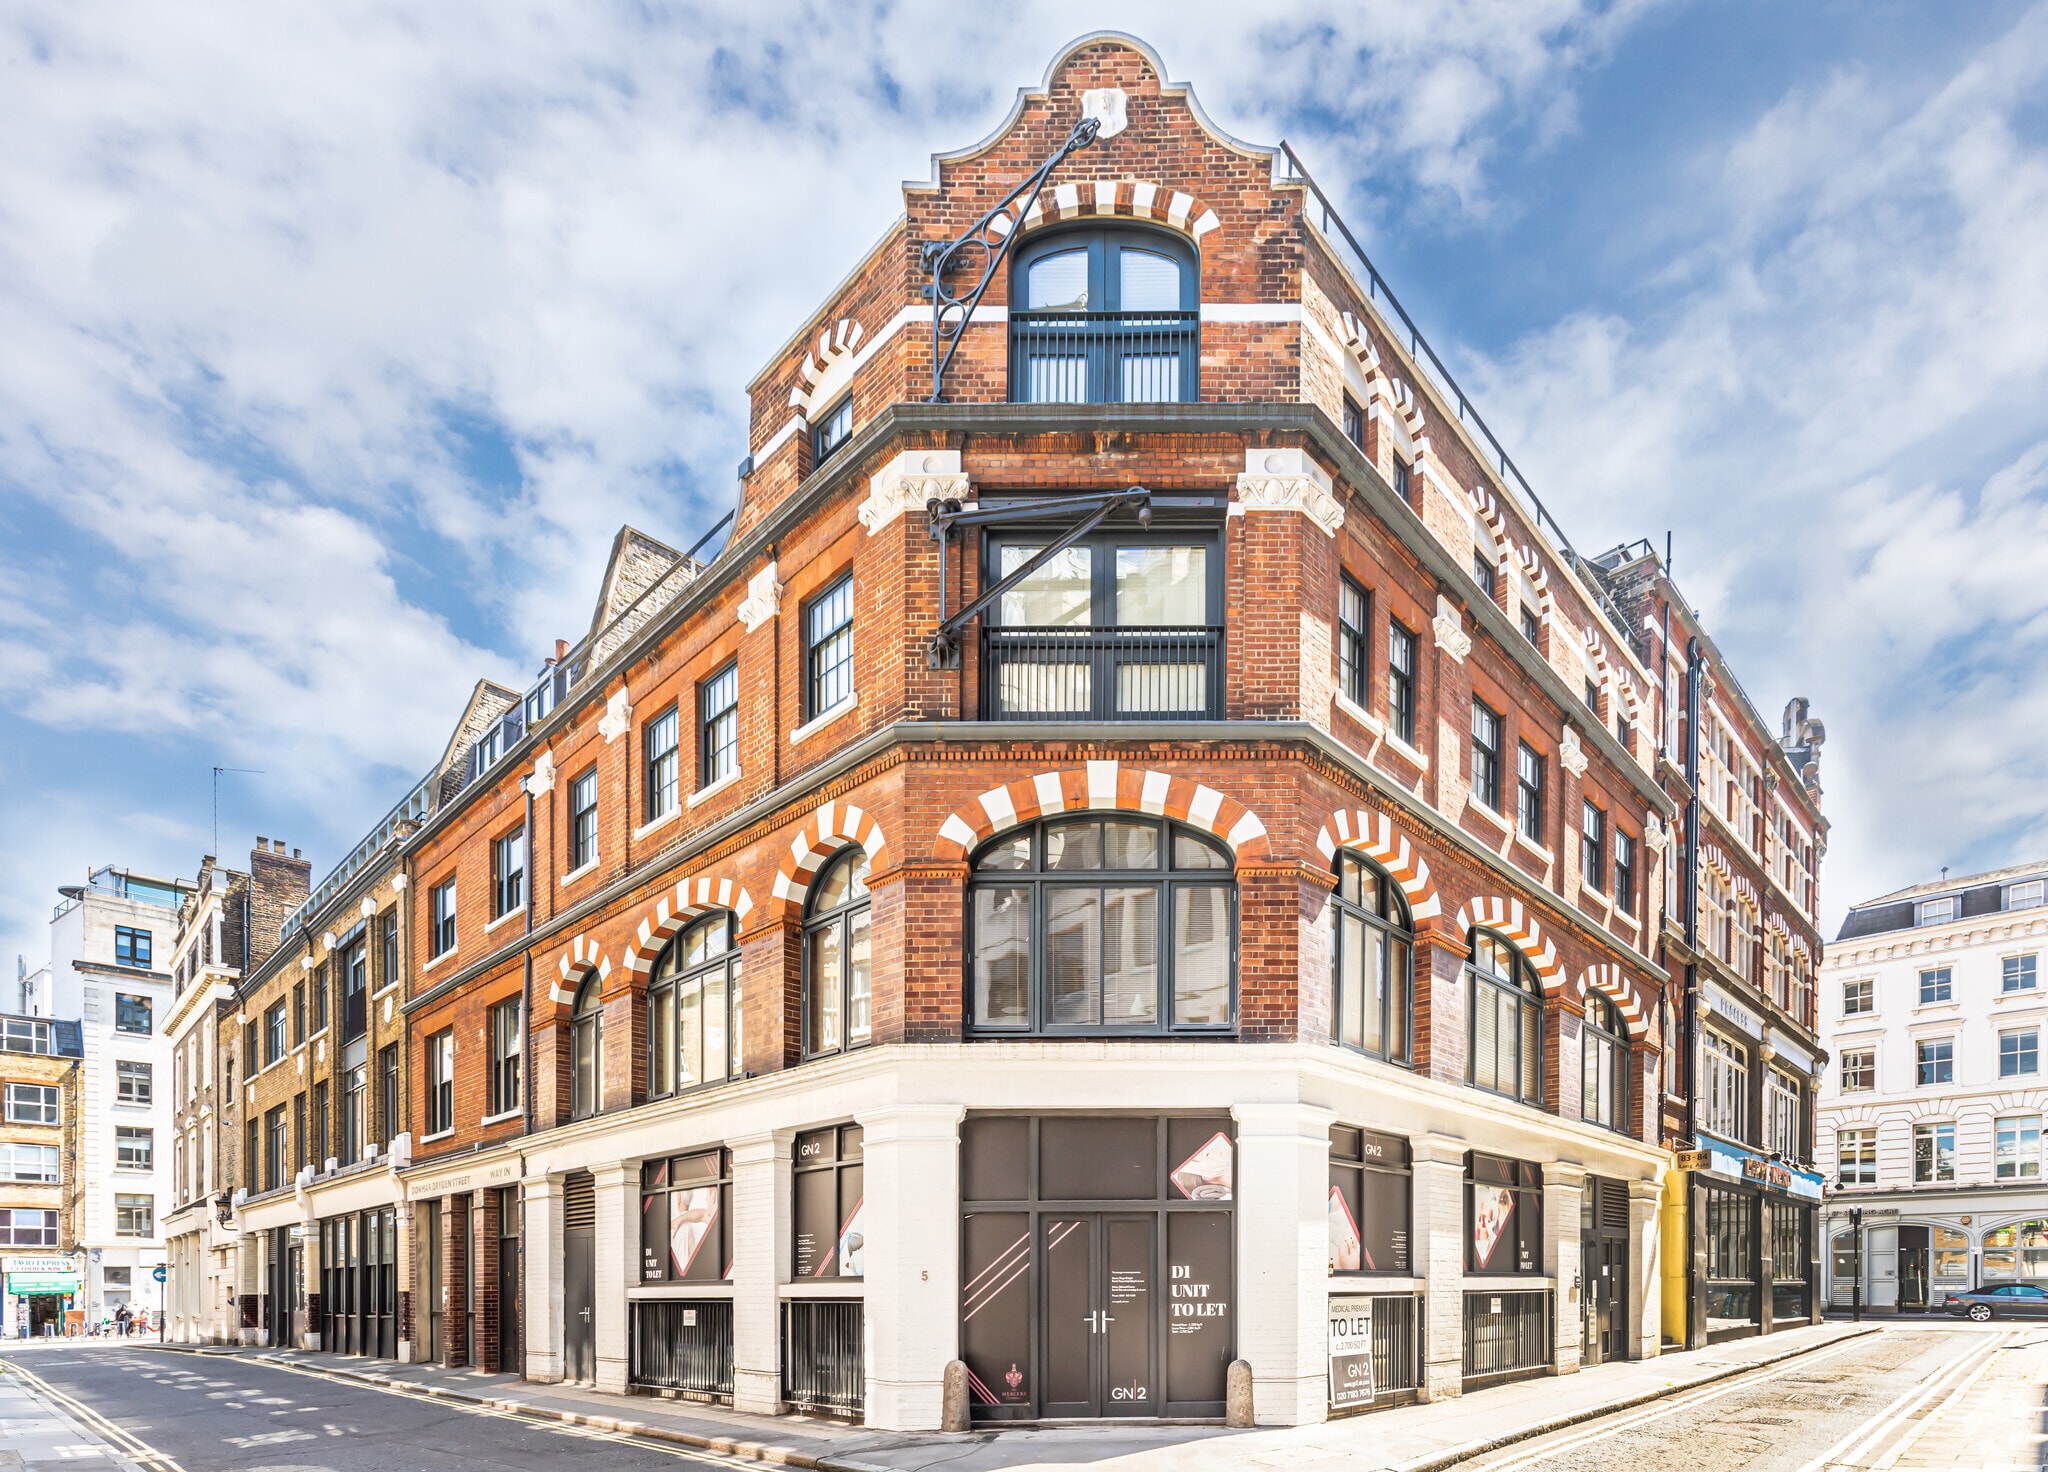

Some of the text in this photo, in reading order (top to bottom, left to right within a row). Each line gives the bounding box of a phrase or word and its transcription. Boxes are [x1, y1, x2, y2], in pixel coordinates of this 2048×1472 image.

[490, 1166, 511, 1179] WAY IN
[432, 1180, 451, 1191] DRYDEN
[452, 1176, 471, 1187] STREET
[645, 1270, 663, 1279] TO LET
[921, 1270, 929, 1281] 5
[1171, 1265, 1191, 1279] D1
[1171, 1284, 1210, 1298] UNIT
[1171, 1303, 1227, 1317] TO LET
[1331, 1304, 1370, 1313] MEDICAL PREMISES
[1330, 1317, 1370, 1337] TO LET
